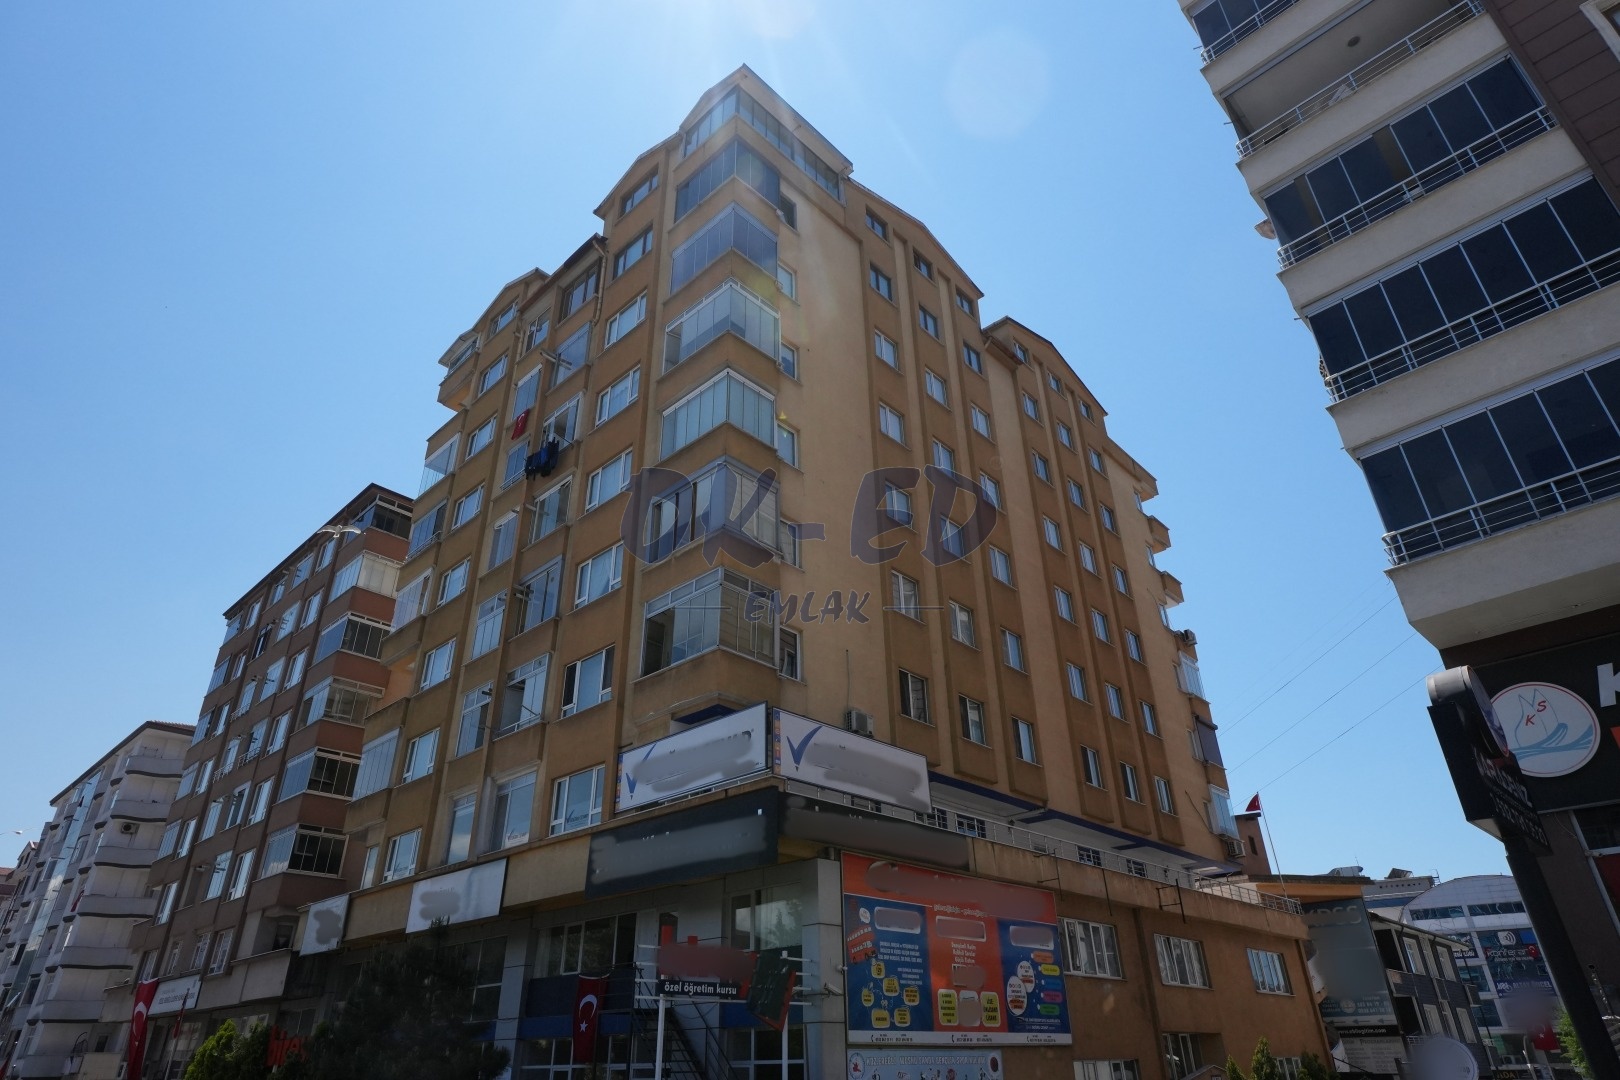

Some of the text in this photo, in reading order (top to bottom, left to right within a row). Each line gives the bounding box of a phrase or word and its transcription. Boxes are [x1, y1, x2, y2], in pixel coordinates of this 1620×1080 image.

[664, 981, 737, 996] özel öğretim kursu
